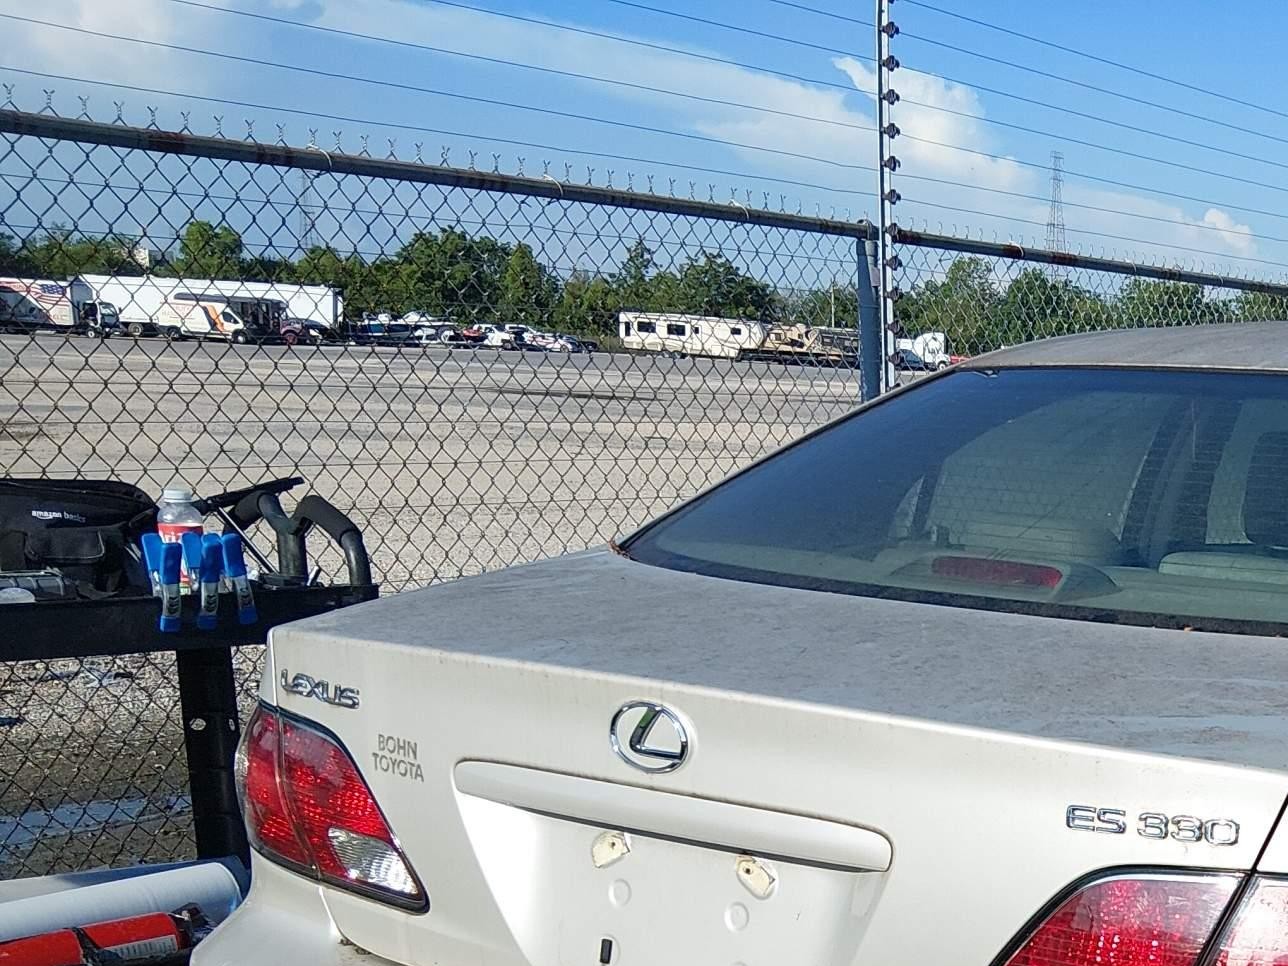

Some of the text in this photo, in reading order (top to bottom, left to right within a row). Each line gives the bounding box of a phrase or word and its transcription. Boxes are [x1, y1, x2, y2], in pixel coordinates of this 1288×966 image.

[31, 510, 63, 519] amazon
[281, 668, 360, 709] LEXUS
[378, 734, 417, 760] BOHN
[372, 752, 424, 782] TOYOTA
[1066, 804, 1240, 846] ES 330
